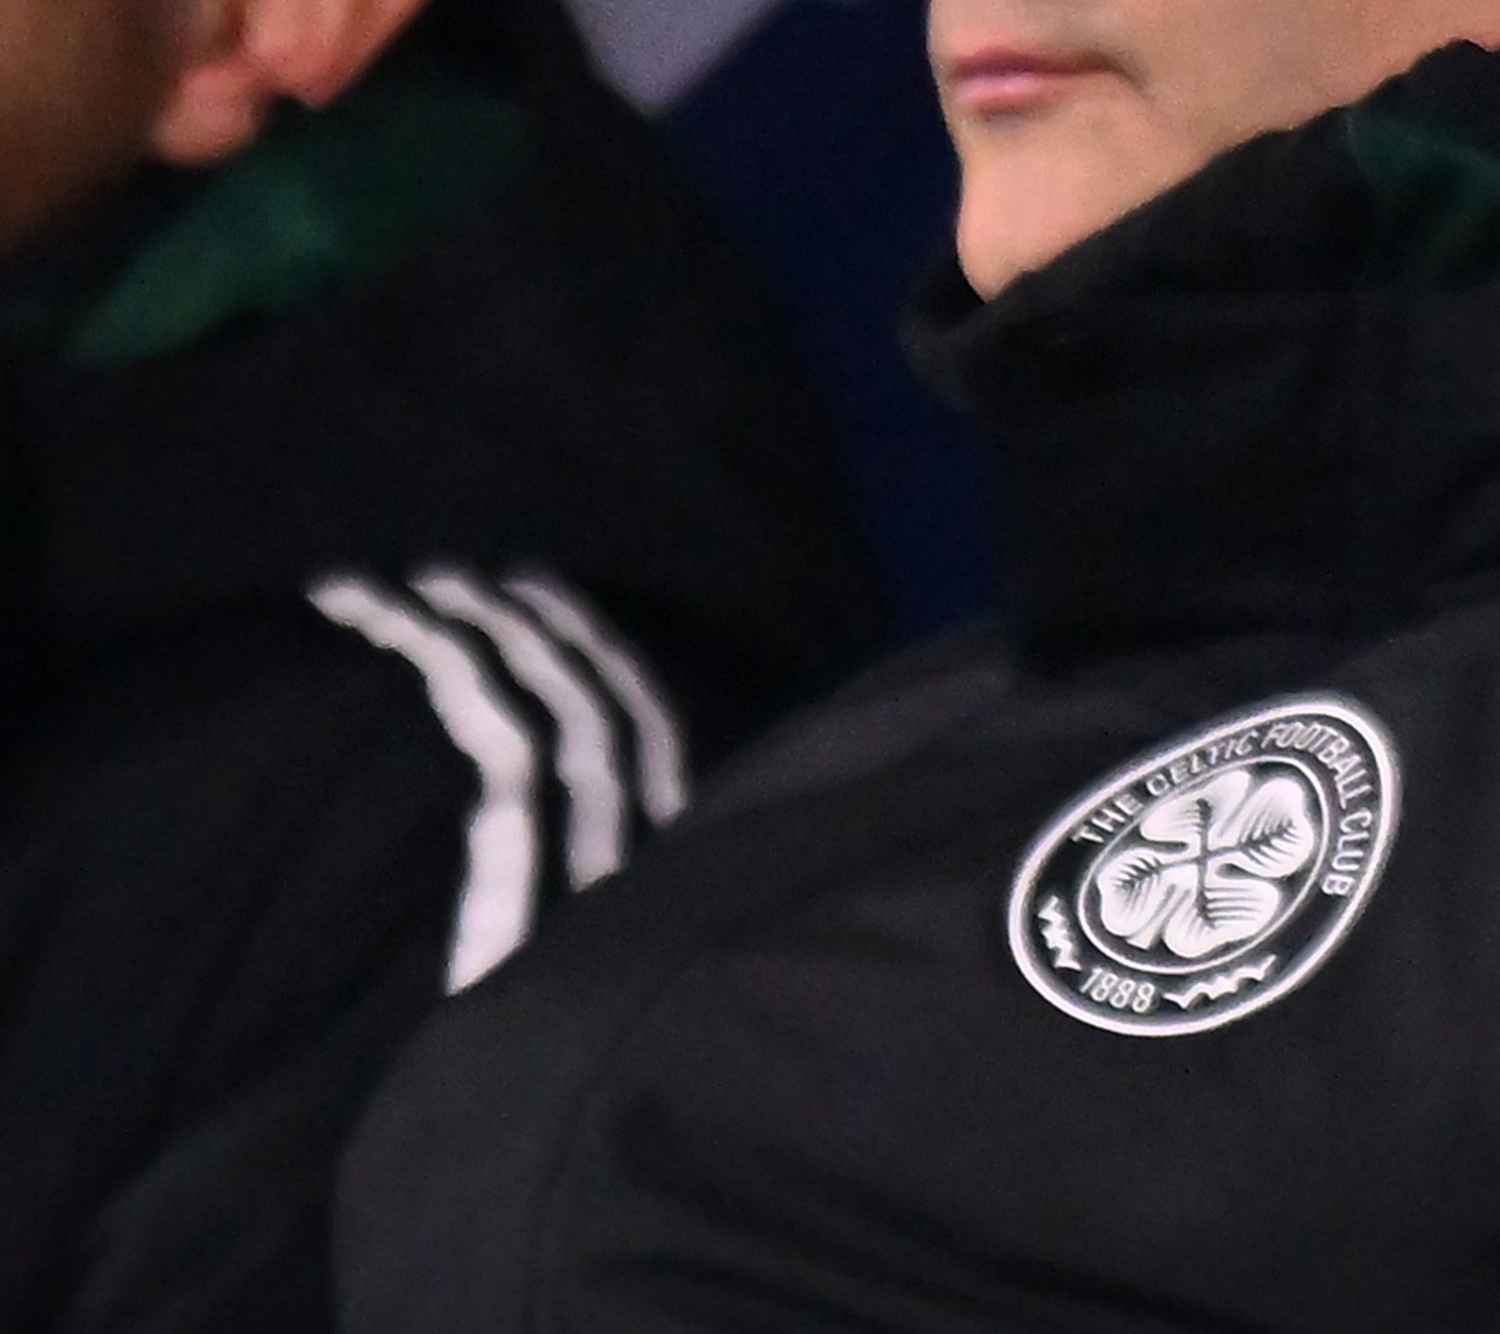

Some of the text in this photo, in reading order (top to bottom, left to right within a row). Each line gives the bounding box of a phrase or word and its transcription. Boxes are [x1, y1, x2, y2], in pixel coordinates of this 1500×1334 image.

[1071, 722, 1373, 896] THE CELTIC FOOTBALL CLUB
[1079, 968, 1156, 1013] 1888
